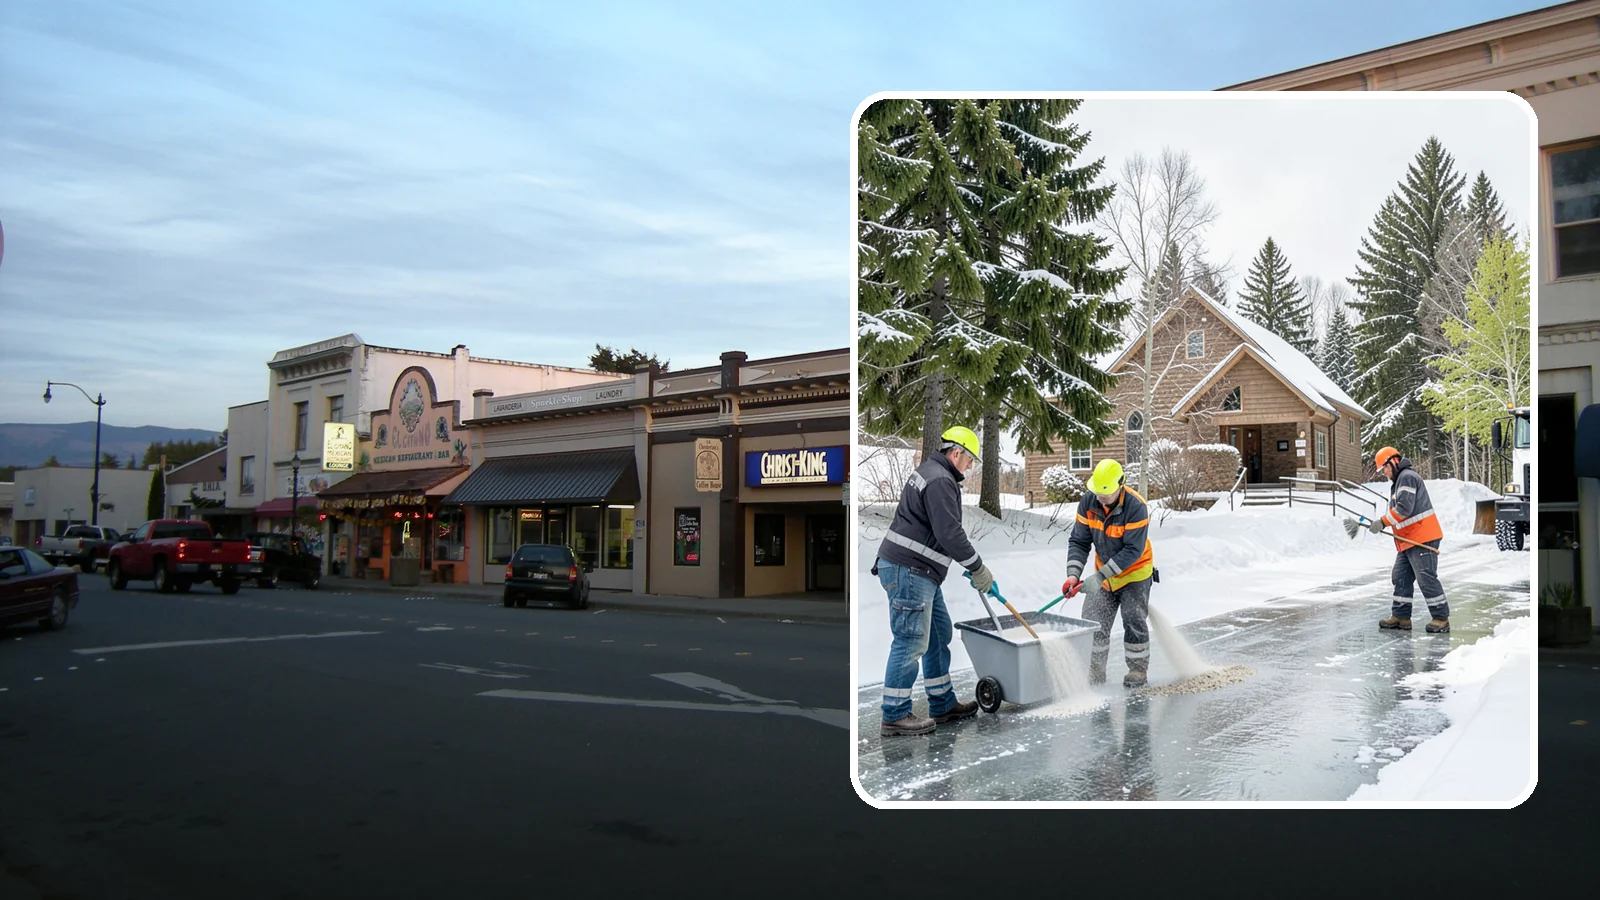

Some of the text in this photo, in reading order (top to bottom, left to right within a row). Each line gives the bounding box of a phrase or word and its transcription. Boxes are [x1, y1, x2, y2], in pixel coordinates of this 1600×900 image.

[531, 394, 583, 408] Sparkle Shop
[595, 389, 624, 400] LAUNDRY
[493, 402, 522, 412] LAVANDERIA
[374, 455, 396, 463] MEXICAN
[398, 452, 433, 461] RESTAURANT
[438, 450, 450, 459] BAR
[761, 450, 827, 477] CHRIST KING
